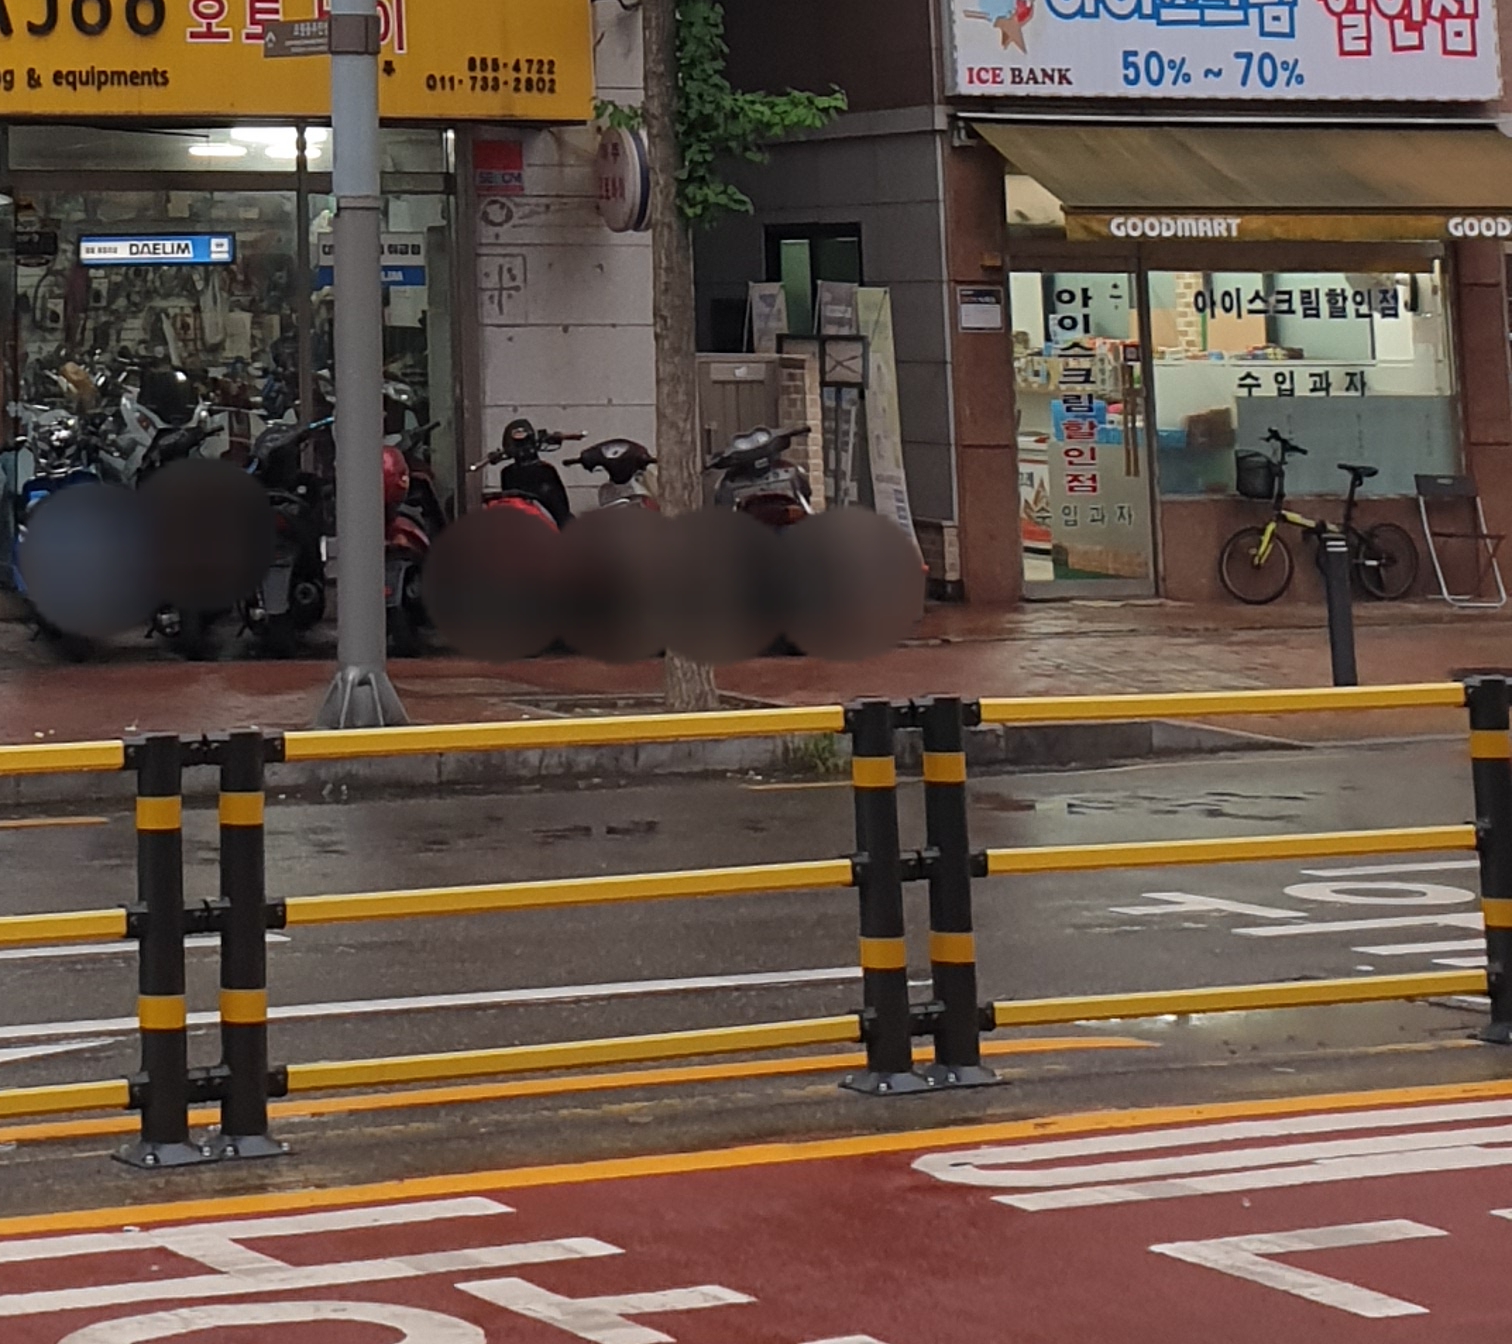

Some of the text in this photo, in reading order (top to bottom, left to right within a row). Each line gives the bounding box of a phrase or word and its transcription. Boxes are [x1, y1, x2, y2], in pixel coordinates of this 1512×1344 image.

[27, 66, 42, 88] &
[53, 65, 169, 91] equipments
[967, 66, 1073, 86] ICE BANK
[1122, 49, 1192, 87] 50%
[1233, 51, 1305, 88] 70%
[1110, 216, 1241, 238] GOODMART
[129, 243, 191, 256] DAELIM
[1193, 286, 1401, 319] 아이스크림할인점
